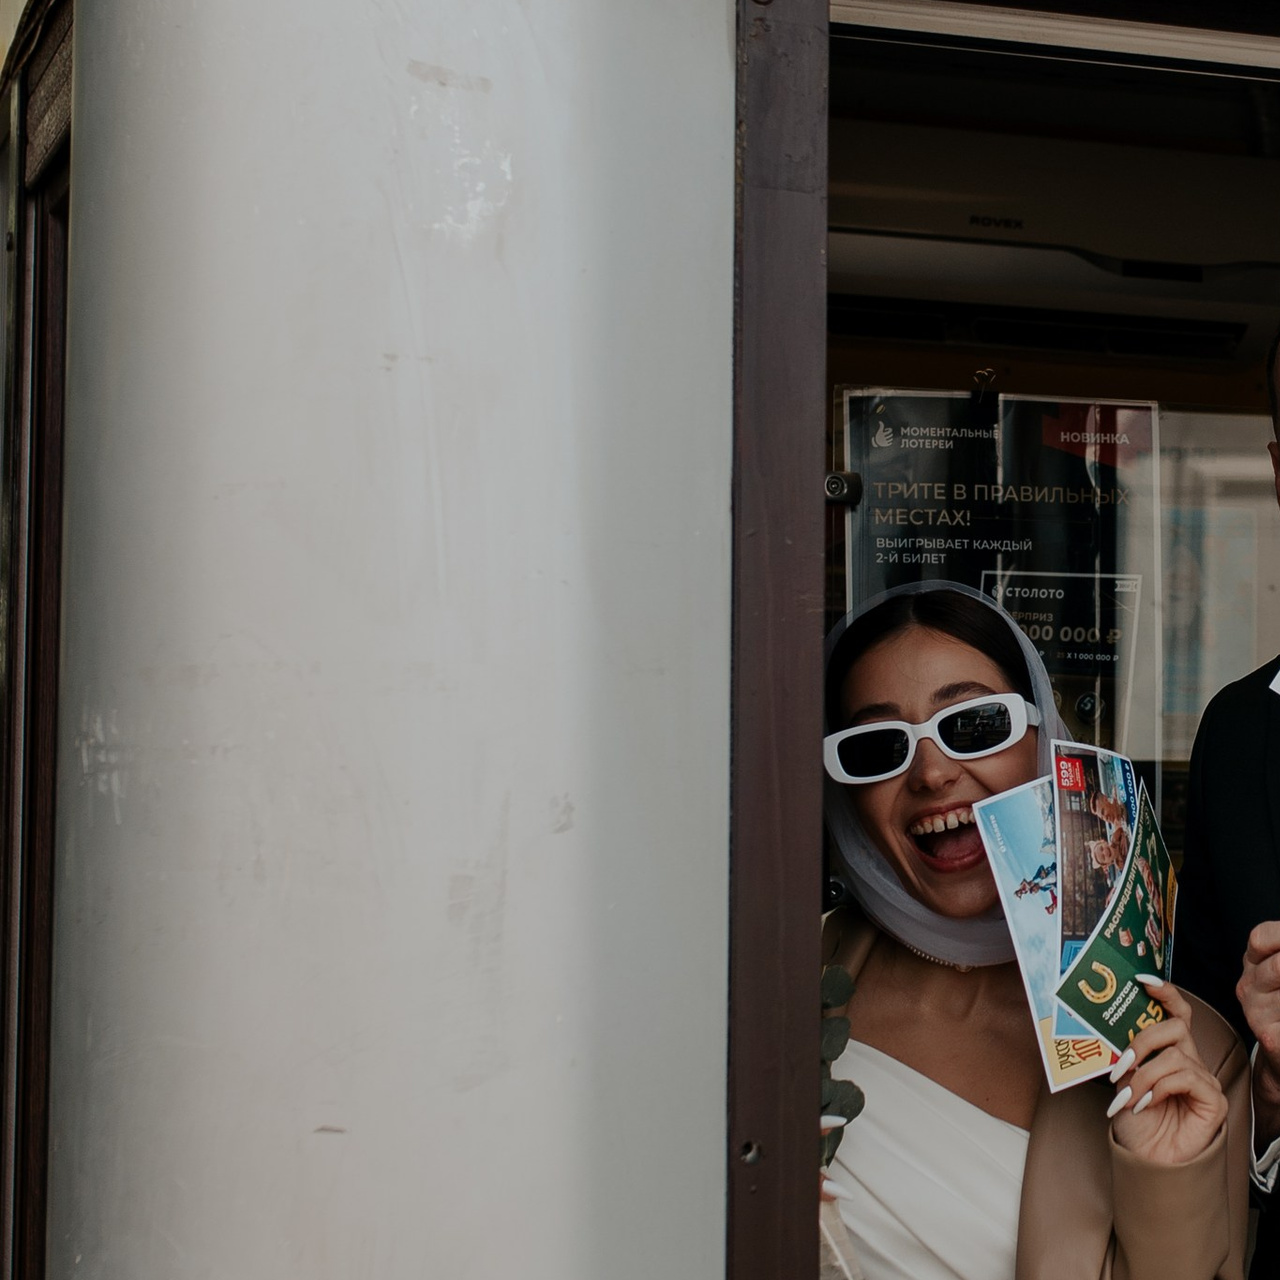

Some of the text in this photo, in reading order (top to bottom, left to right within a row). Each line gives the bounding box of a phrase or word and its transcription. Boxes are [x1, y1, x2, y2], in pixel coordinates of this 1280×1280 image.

[900, 426, 1000, 439] МОМЕНТАЛЬНЫЕ
[1060, 431, 1130, 445] НОВИНКА
[900, 439, 954, 450] ЛОТЕРЕИ
[872, 482, 1130, 506] ТРИТЕ В ПРАВИЛЬНЫХ
[874, 507, 972, 527] МЕСТАХ!
[876, 537, 1033, 552] ВЫИГРЫВАЕТ КАЖДЫЙ
[876, 551, 947, 564] 2-Й БИЛЕТ
[1005, 587, 1065, 599] СТОЛОТО
[1060, 626, 1100, 644] 000
[1060, 760, 1070, 787] 599
[1102, 980, 1134, 1021] Золотая
[1108, 985, 1139, 1027] подкова
[1128, 999, 1163, 1043] 55
